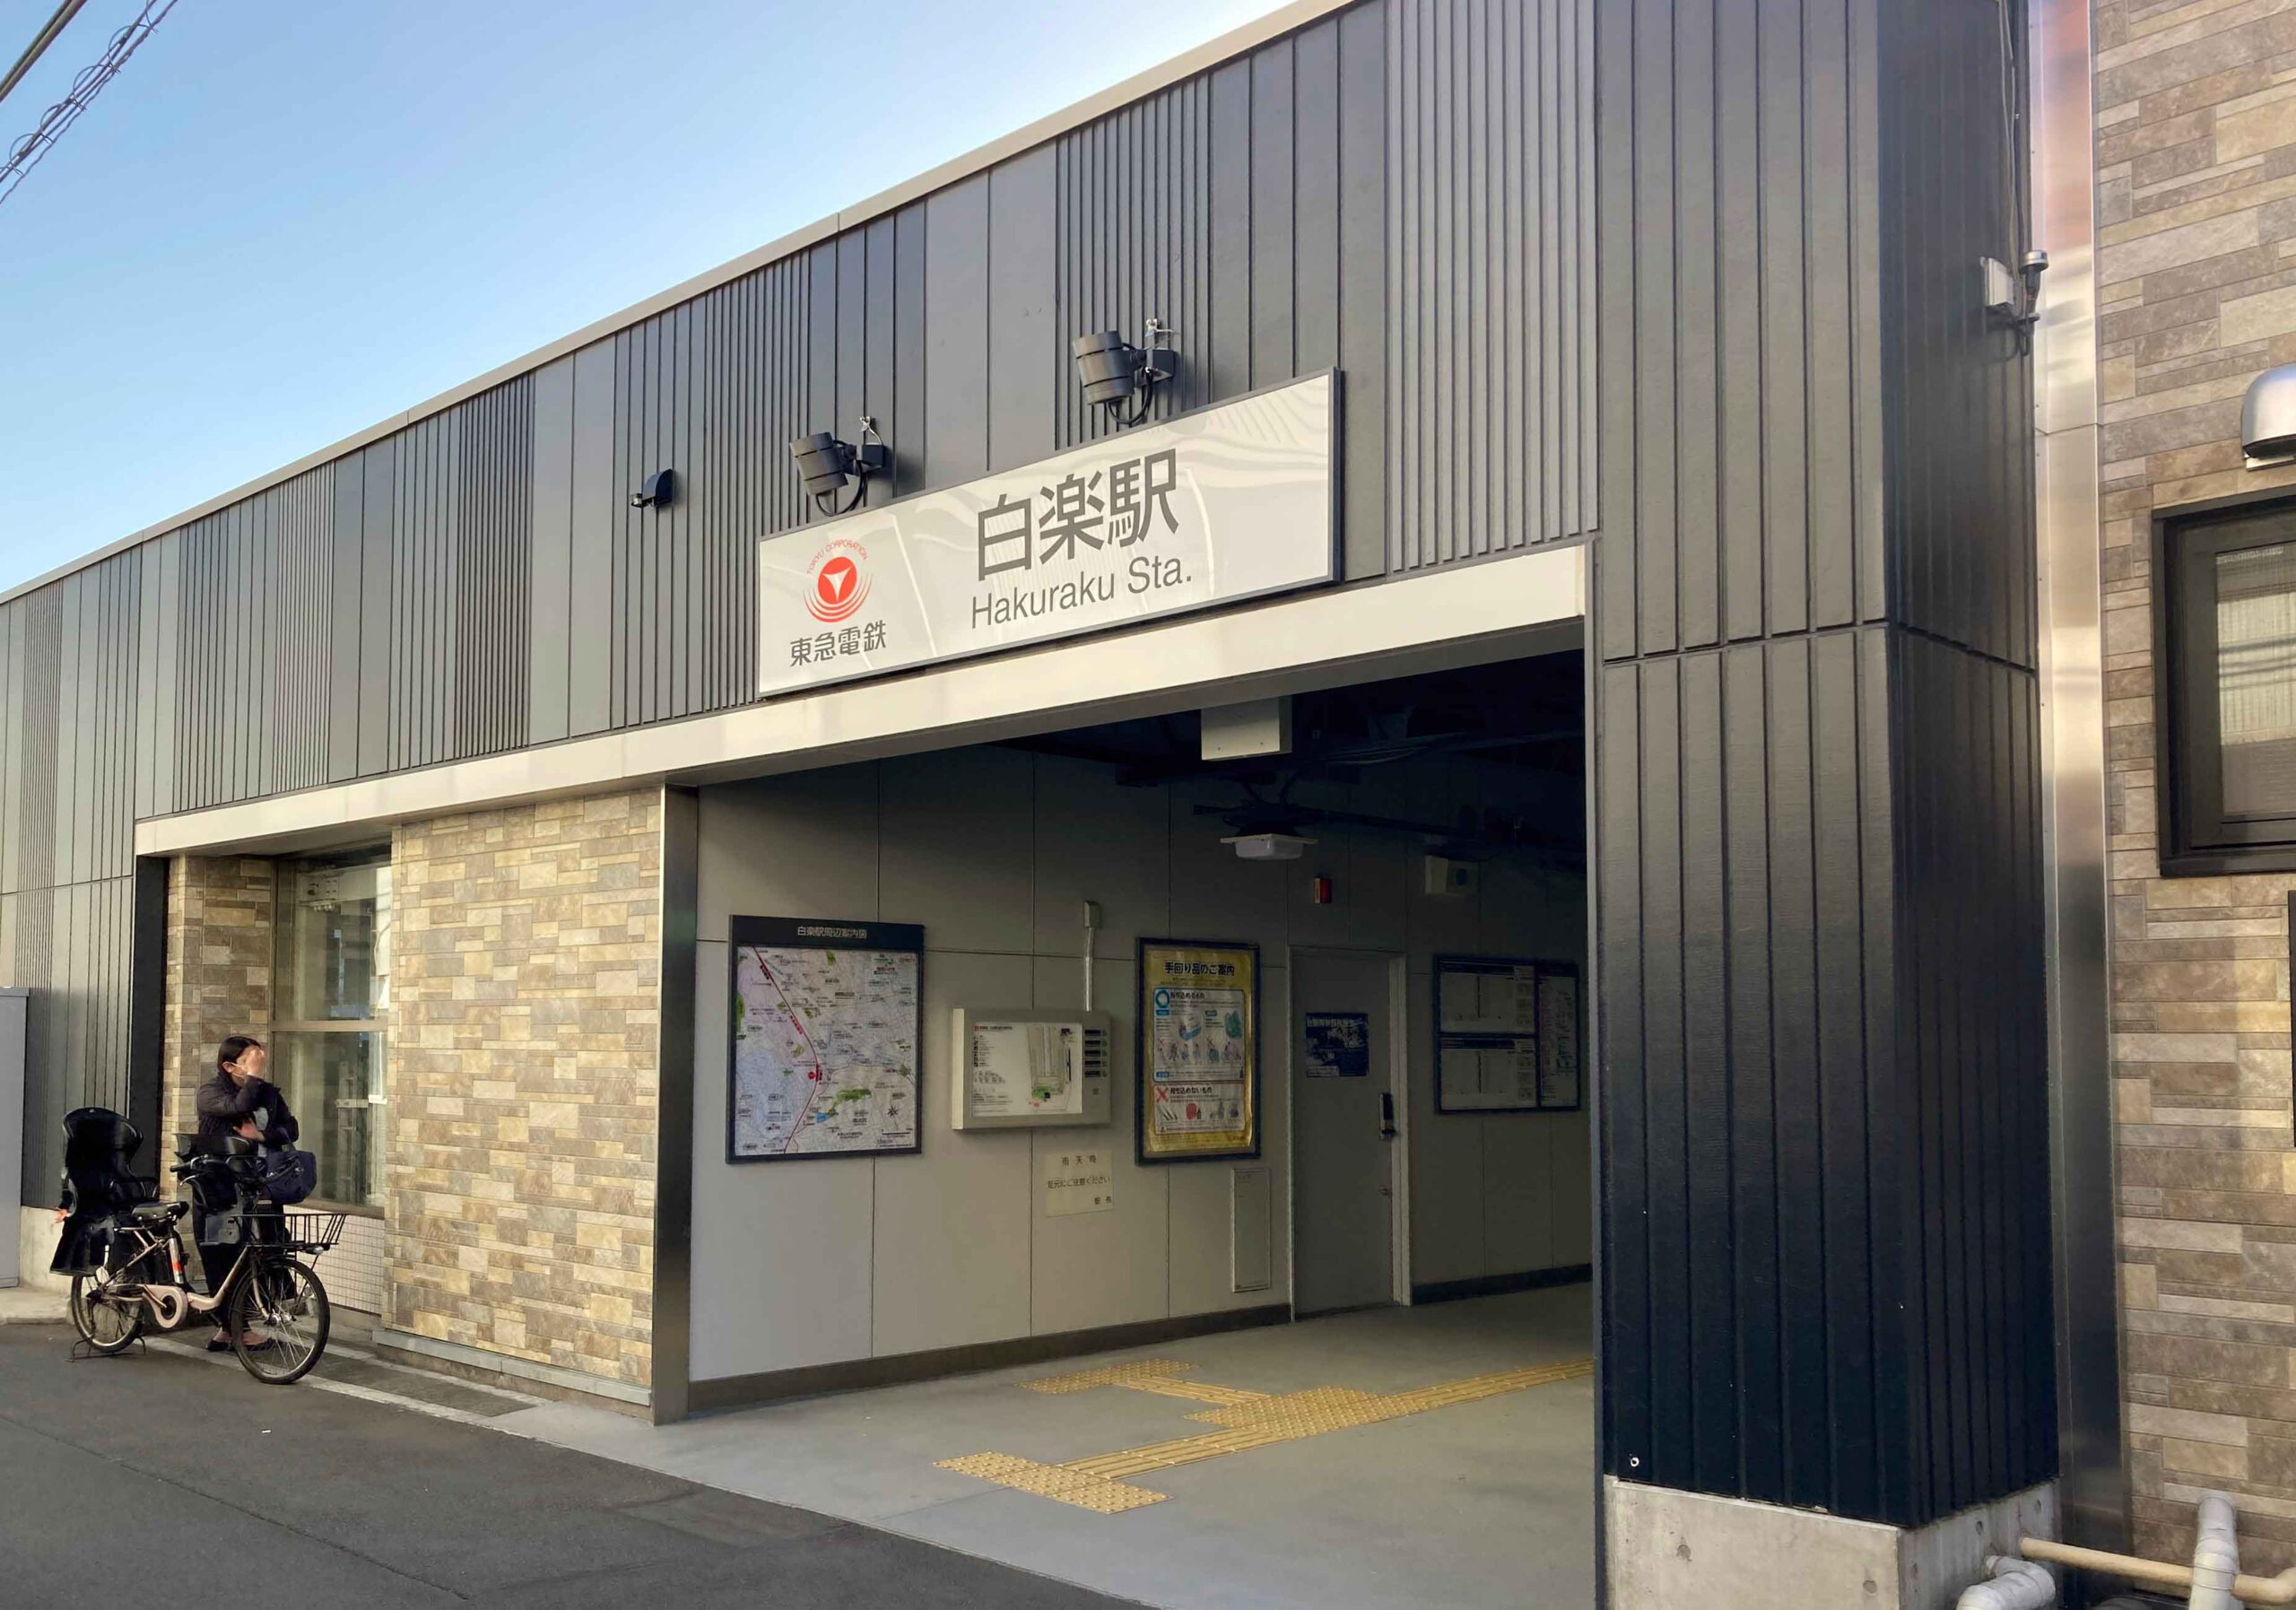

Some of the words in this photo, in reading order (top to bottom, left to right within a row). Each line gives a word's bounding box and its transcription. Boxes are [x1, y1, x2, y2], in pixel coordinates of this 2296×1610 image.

[978, 448, 1178, 581] 白楽駅
[972, 571, 1115, 628] Hakuraku
[1128, 555, 1192, 594] Sta.
[789, 620, 886, 666] 東急電鉄
[1164, 962, 1235, 976] 手回り品のご案内
